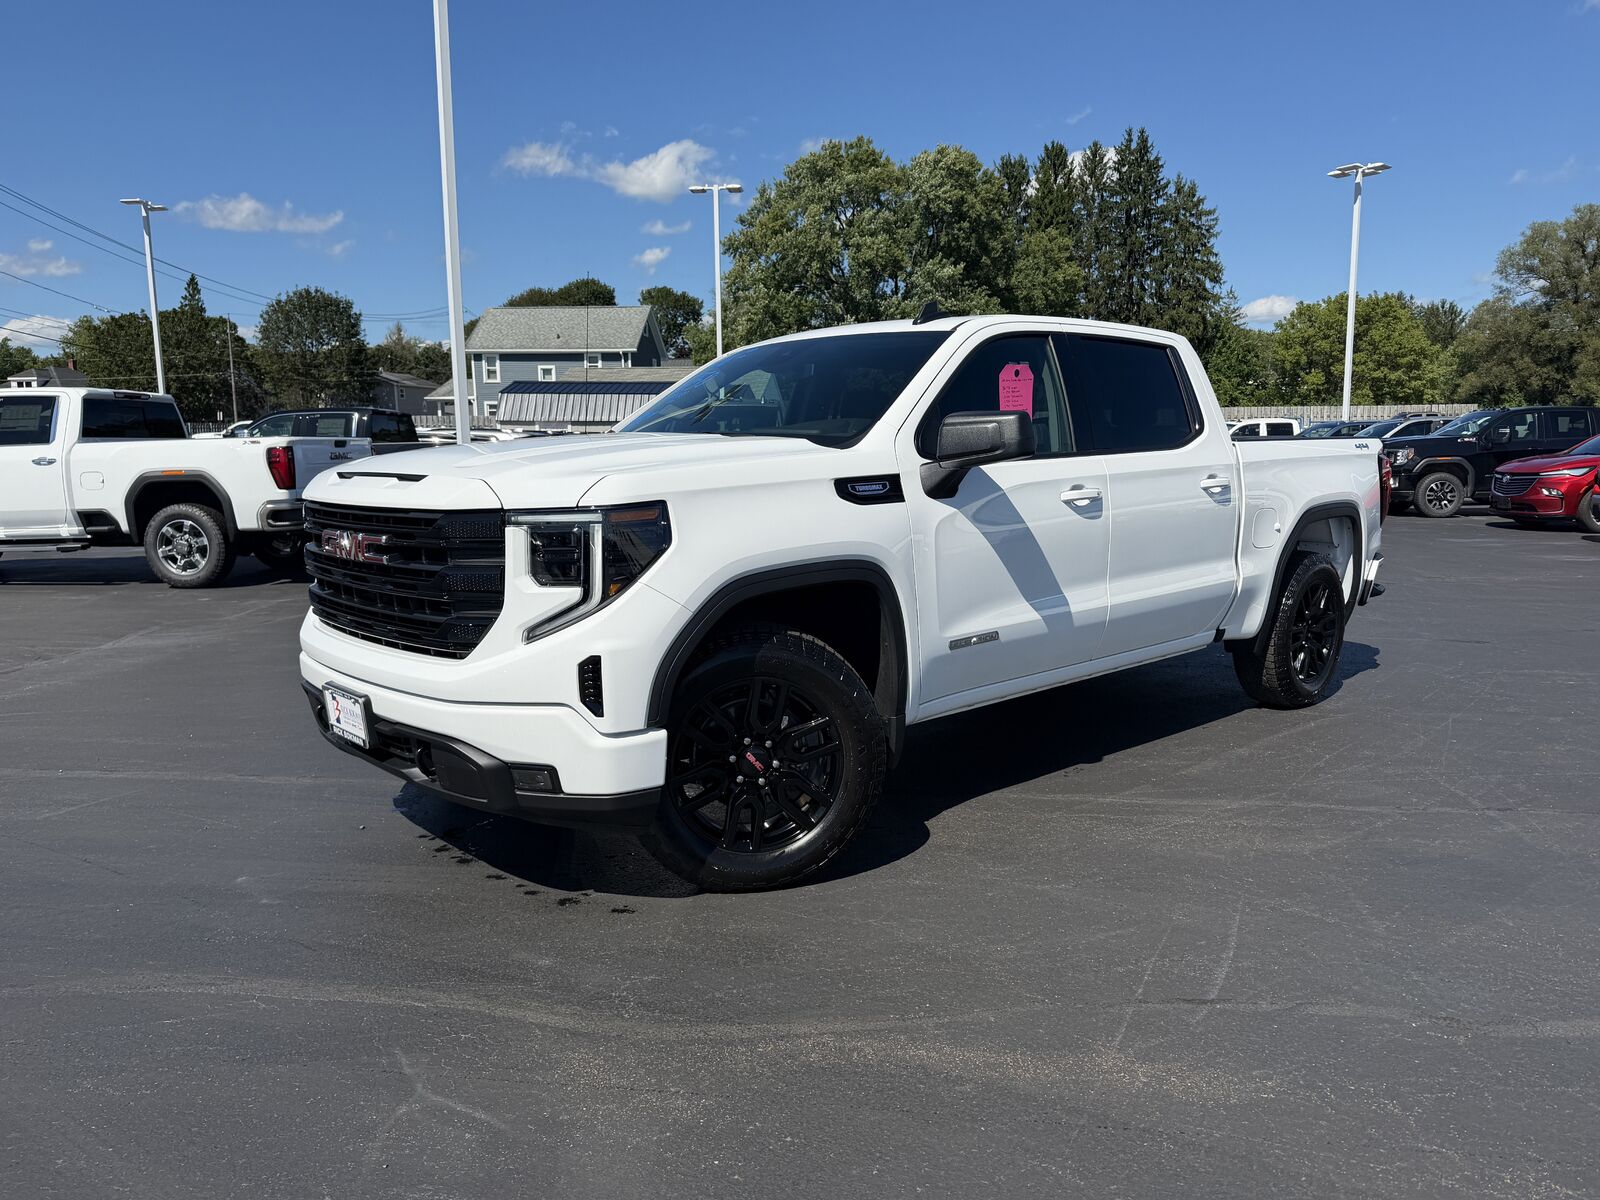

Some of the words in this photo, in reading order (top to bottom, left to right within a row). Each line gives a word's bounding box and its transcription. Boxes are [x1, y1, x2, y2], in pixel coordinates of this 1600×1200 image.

[330, 452, 353, 460] GMC
[321, 528, 389, 565] GMC
[746, 752, 764, 771] GMC
